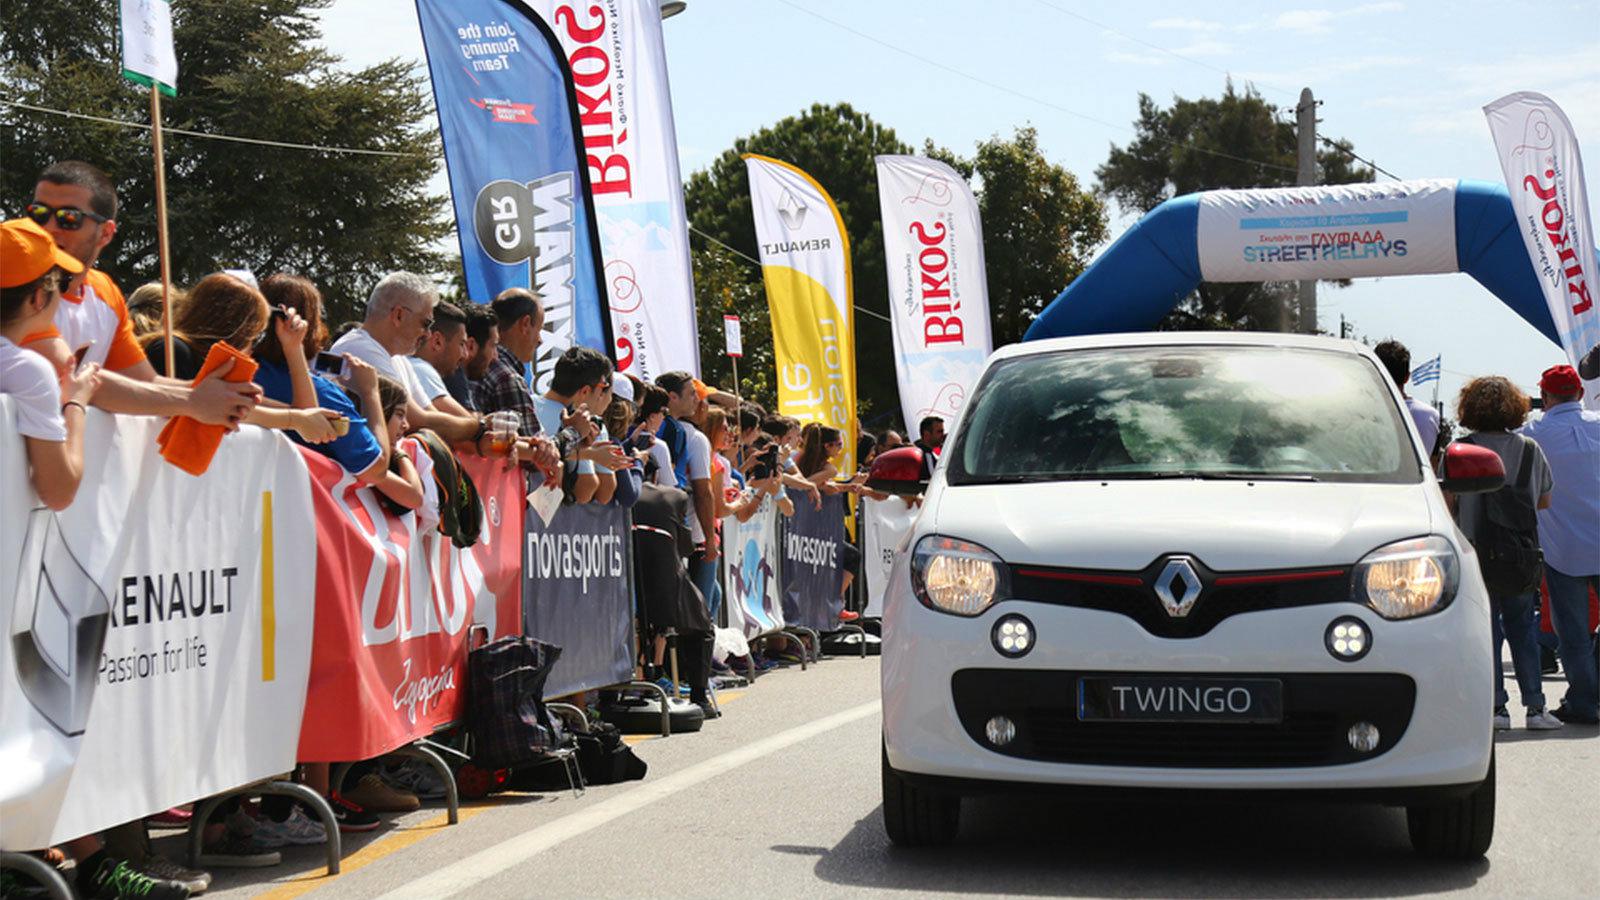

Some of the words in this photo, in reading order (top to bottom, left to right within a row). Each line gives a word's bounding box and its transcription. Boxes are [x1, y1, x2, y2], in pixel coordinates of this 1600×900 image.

[1311, 230, 1385, 246] ΓΛΥΦΑΔΑ
[527, 525, 623, 594] novasports
[162, 640, 182, 675] for
[184, 635, 207, 669] life
[1111, 686, 1252, 713] TWINGO
